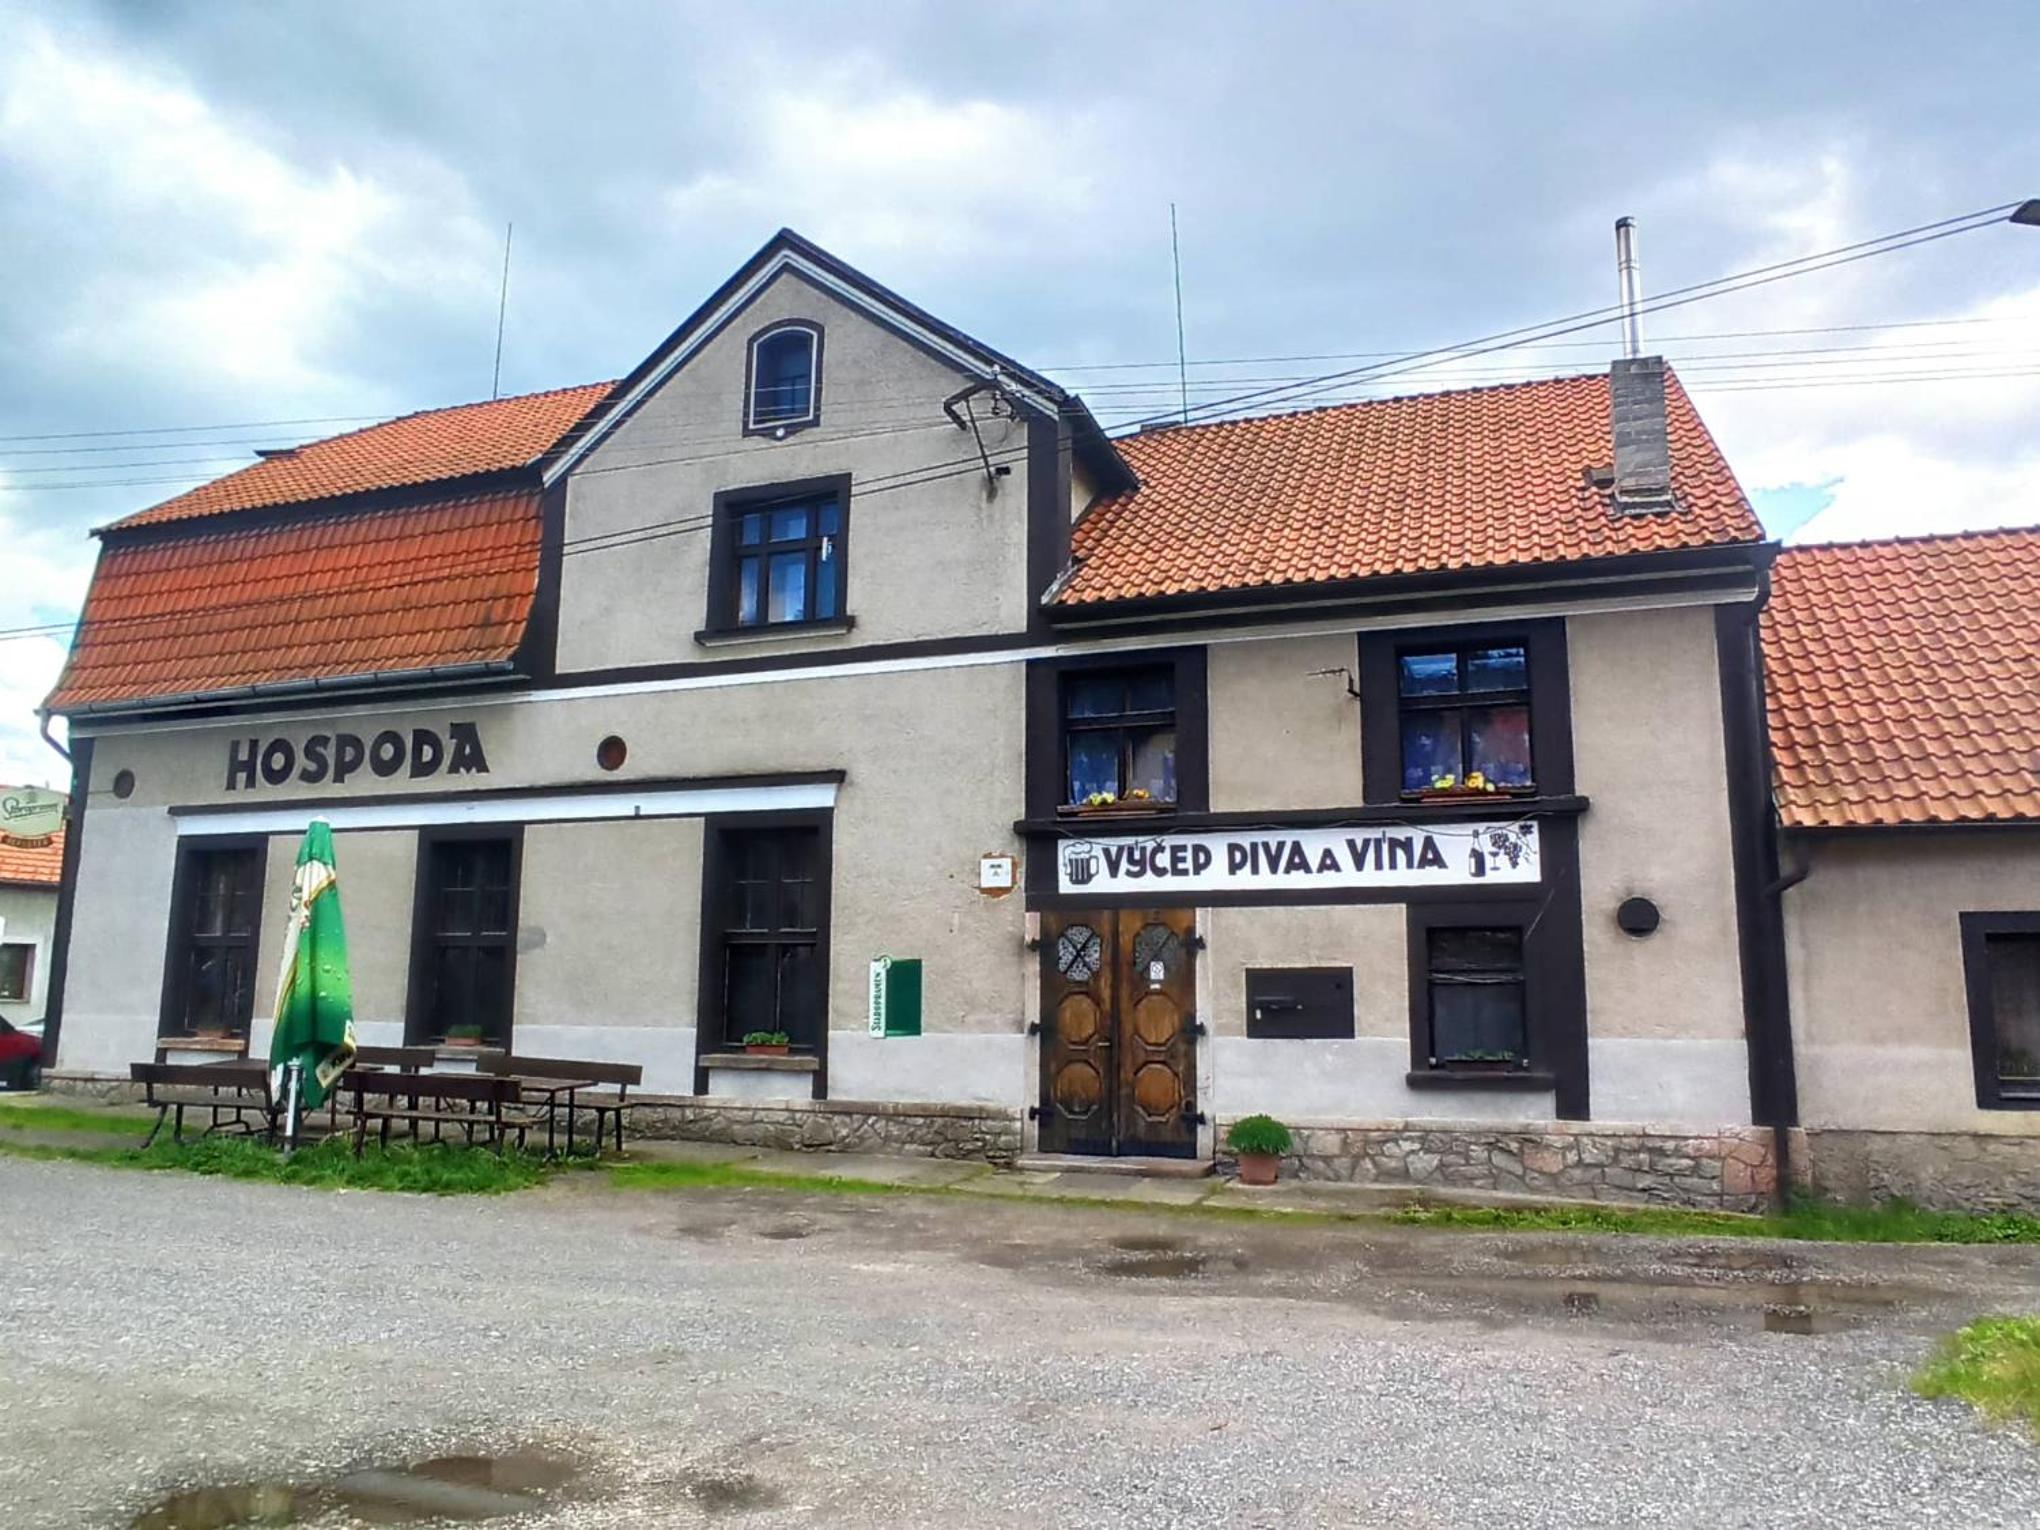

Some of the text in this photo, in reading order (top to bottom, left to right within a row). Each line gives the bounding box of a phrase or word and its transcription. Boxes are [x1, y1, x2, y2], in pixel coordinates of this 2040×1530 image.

[225, 722, 489, 791] HOSPODA
[1227, 840, 1313, 876] PIVA
[1344, 830, 1448, 872] VÍNA
